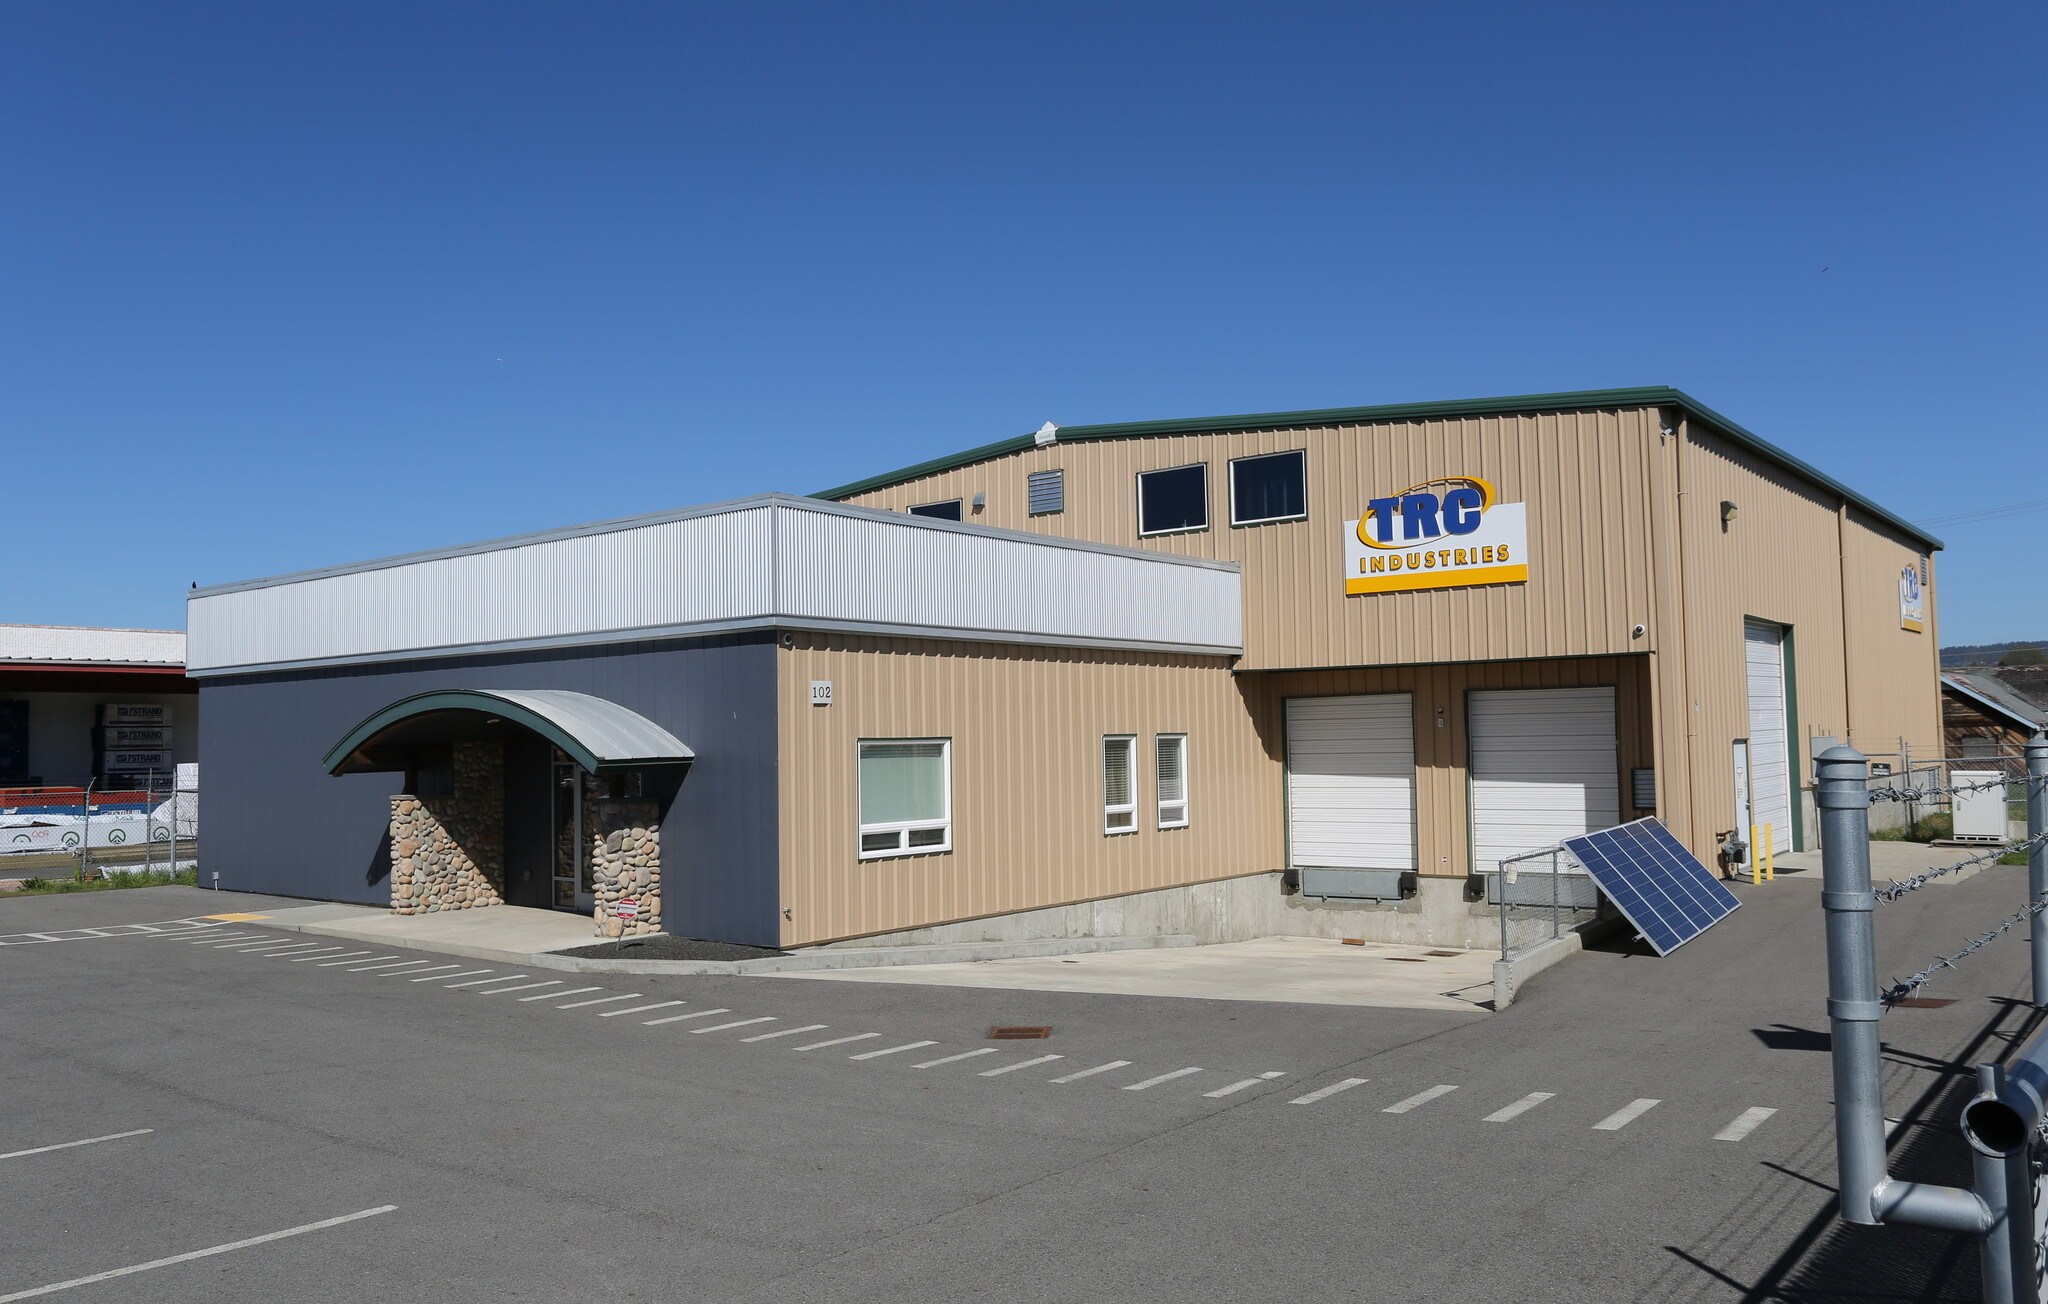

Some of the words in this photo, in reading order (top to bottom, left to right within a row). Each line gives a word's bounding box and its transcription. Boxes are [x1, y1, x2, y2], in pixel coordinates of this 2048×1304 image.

[1367, 488, 1482, 542] TRC
[1360, 544, 1510, 574] INDUSTRIES
[812, 686, 831, 698] 102
